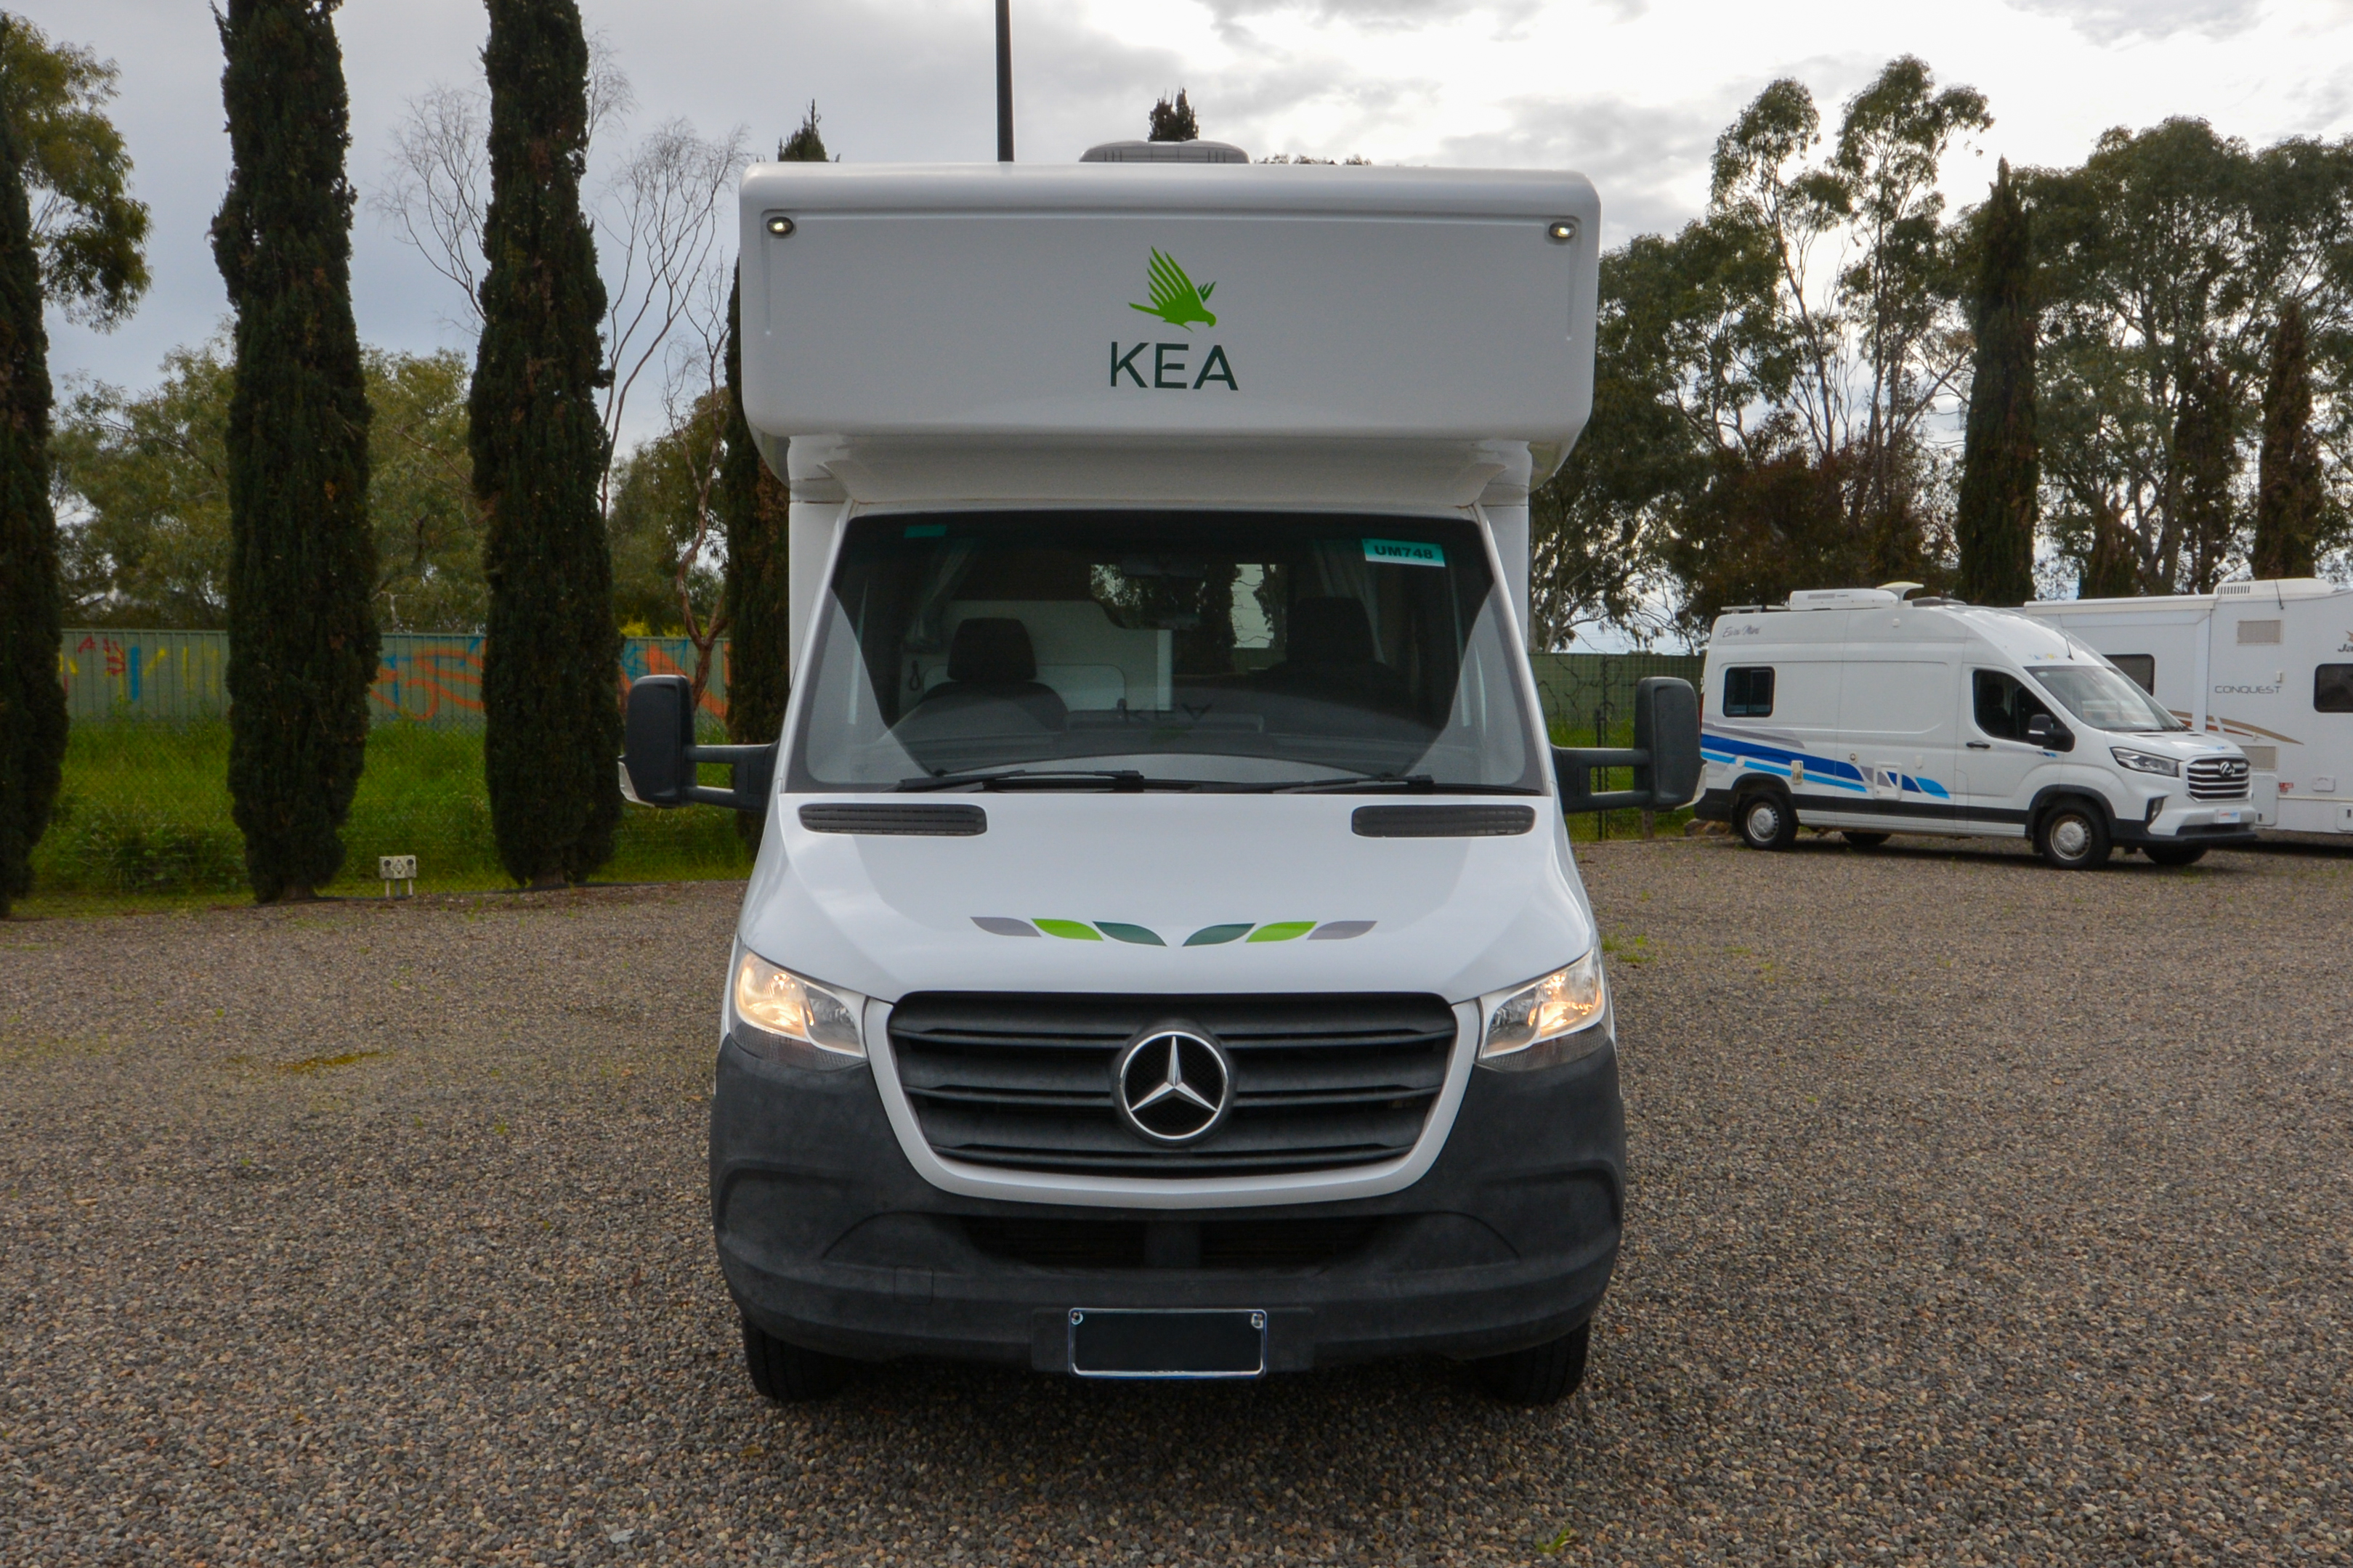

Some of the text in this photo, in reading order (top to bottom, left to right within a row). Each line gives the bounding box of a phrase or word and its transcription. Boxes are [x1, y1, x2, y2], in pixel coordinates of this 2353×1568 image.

[1110, 341, 1239, 391] KEA
[1374, 545, 1433, 559] UM748
[2214, 685, 2281, 694] CONQUEST
